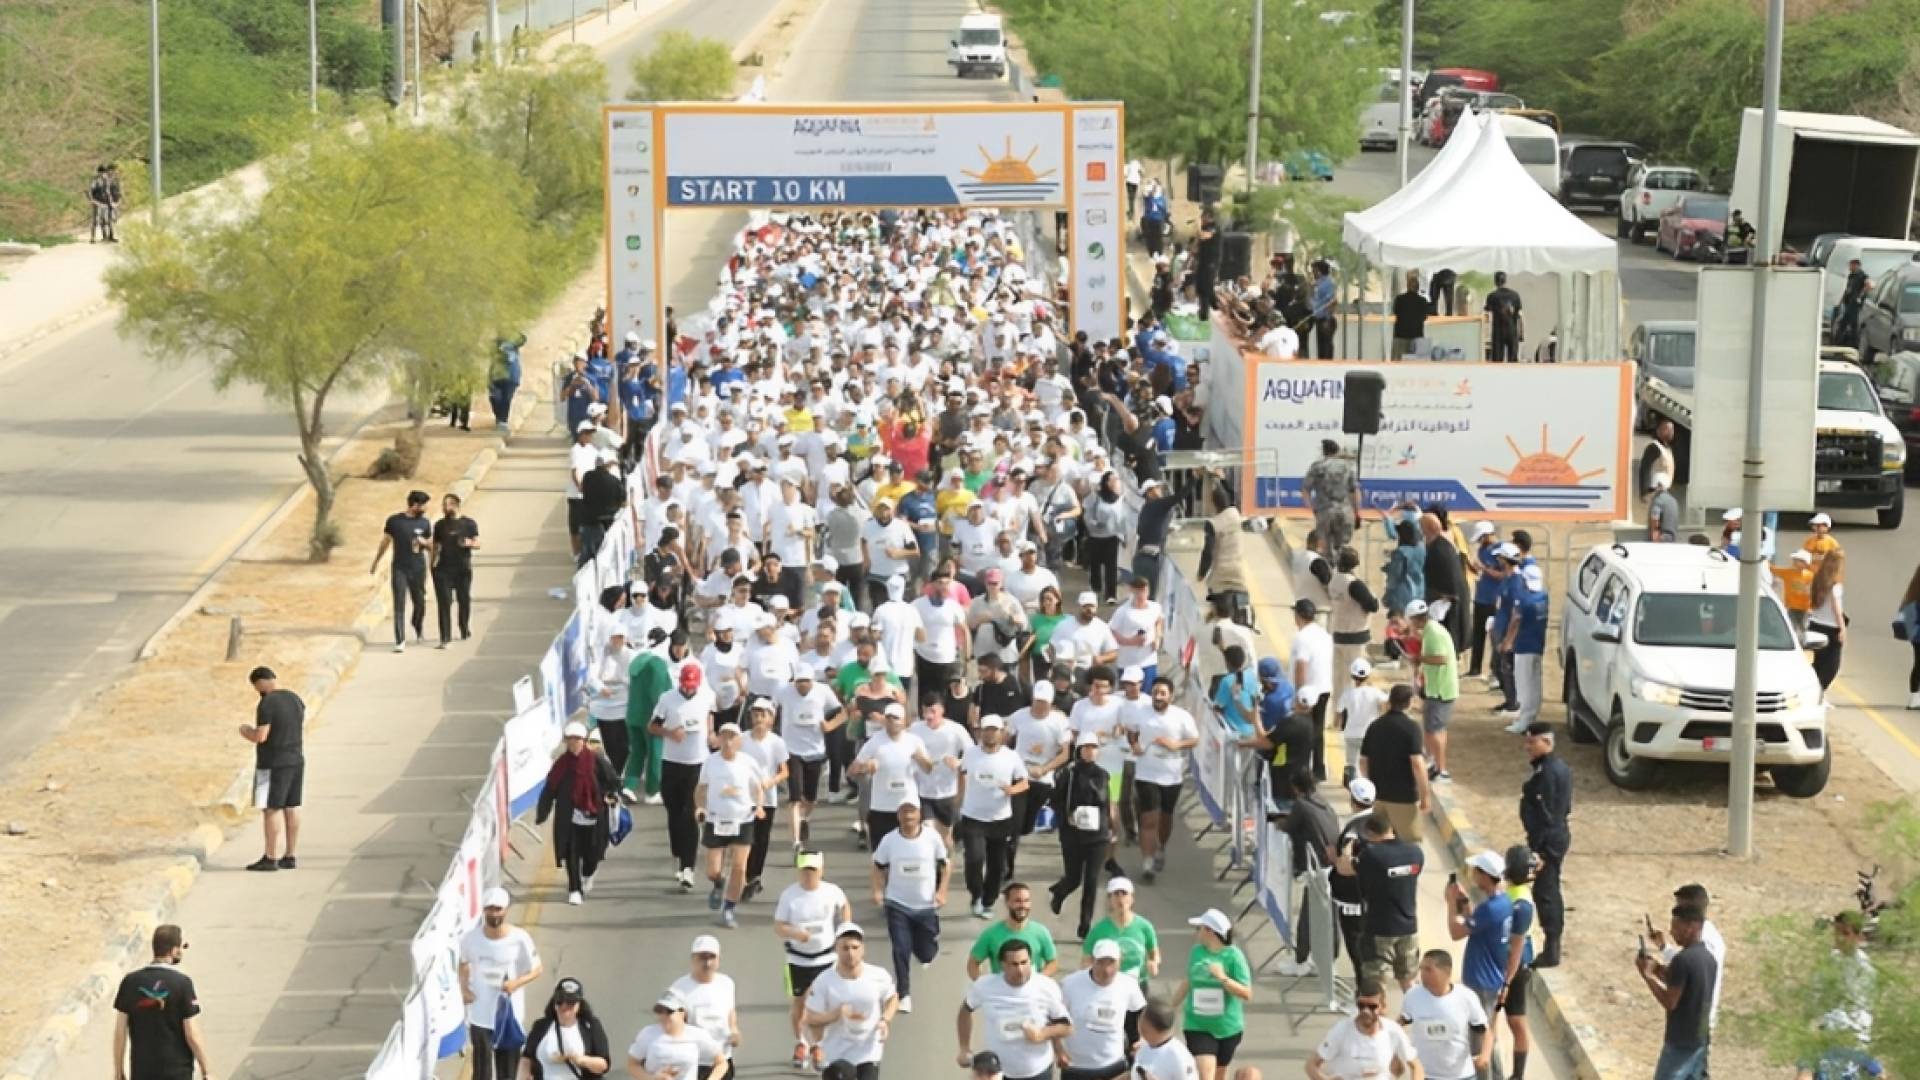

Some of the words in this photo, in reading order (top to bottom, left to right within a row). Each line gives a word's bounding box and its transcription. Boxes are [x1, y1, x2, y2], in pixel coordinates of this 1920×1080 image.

[681, 179, 757, 201] START
[771, 179, 801, 201] 10
[809, 179, 846, 201] KM
[1263, 378, 1344, 404] AQUAFIN
